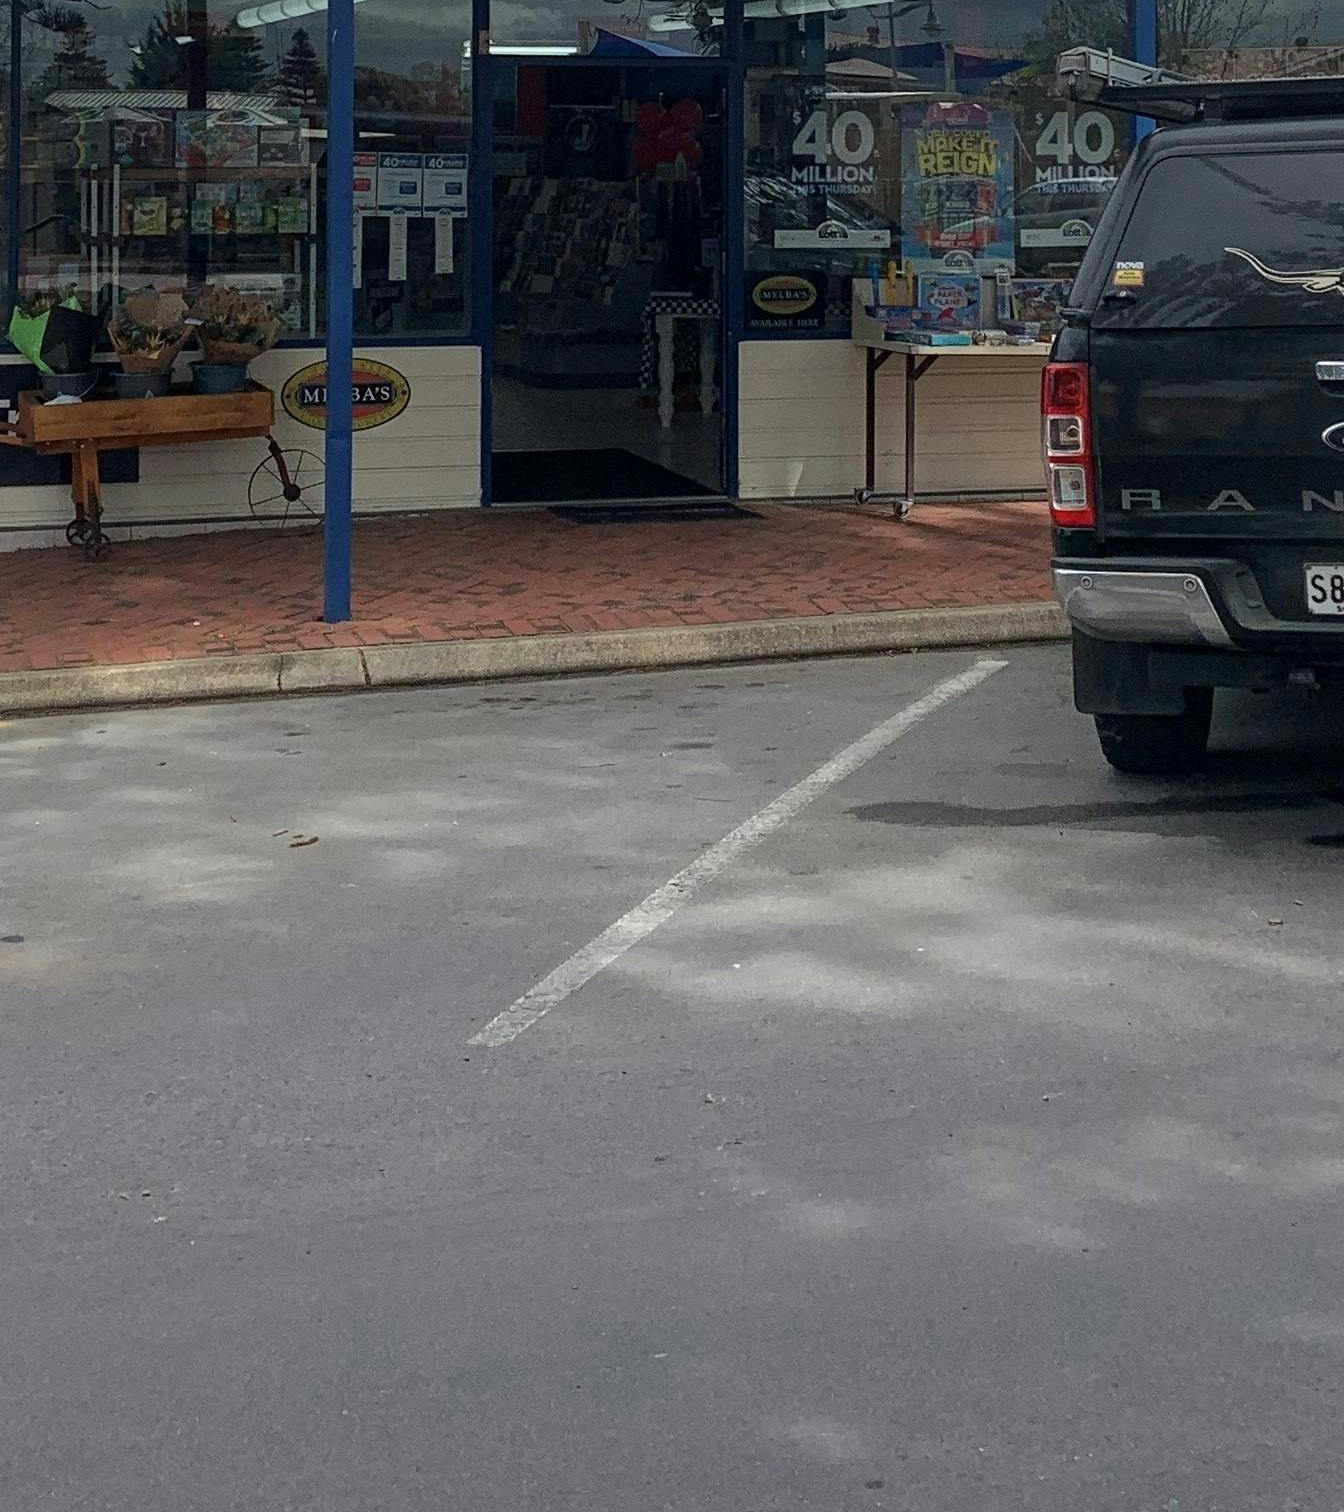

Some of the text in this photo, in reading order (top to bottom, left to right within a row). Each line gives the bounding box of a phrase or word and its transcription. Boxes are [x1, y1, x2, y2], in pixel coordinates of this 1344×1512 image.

[917, 137, 976, 154] MAKE
[917, 152, 997, 176] REIGN
[791, 165, 874, 183] MILLION
[1036, 165, 1115, 183] MILLION
[819, 184, 872, 195] THURSDAY
[303, 386, 391, 403] MBA'S
